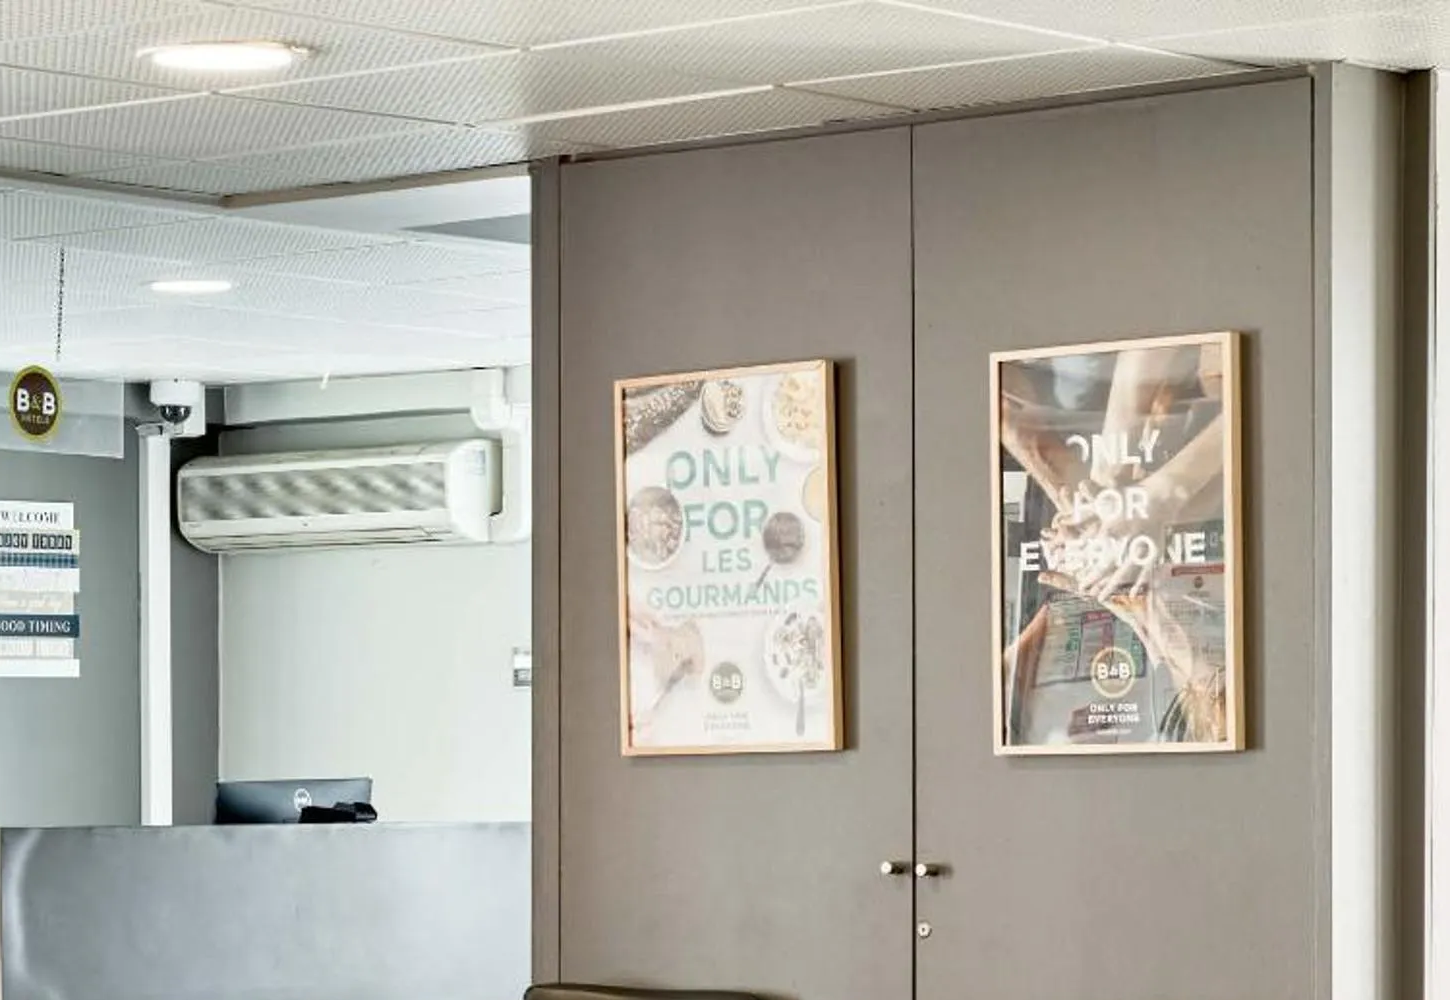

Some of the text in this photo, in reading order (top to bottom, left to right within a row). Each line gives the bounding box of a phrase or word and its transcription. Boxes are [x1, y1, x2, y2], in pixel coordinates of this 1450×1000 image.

[17, 387, 55, 416] B&B
[665, 445, 781, 490] ONLY
[683, 499, 769, 542] FOR
[702, 547, 753, 574] LES
[646, 577, 819, 611] GOURMANDS
[28, 619, 71, 633] TIMING
[1097, 661, 1131, 680] B&B
